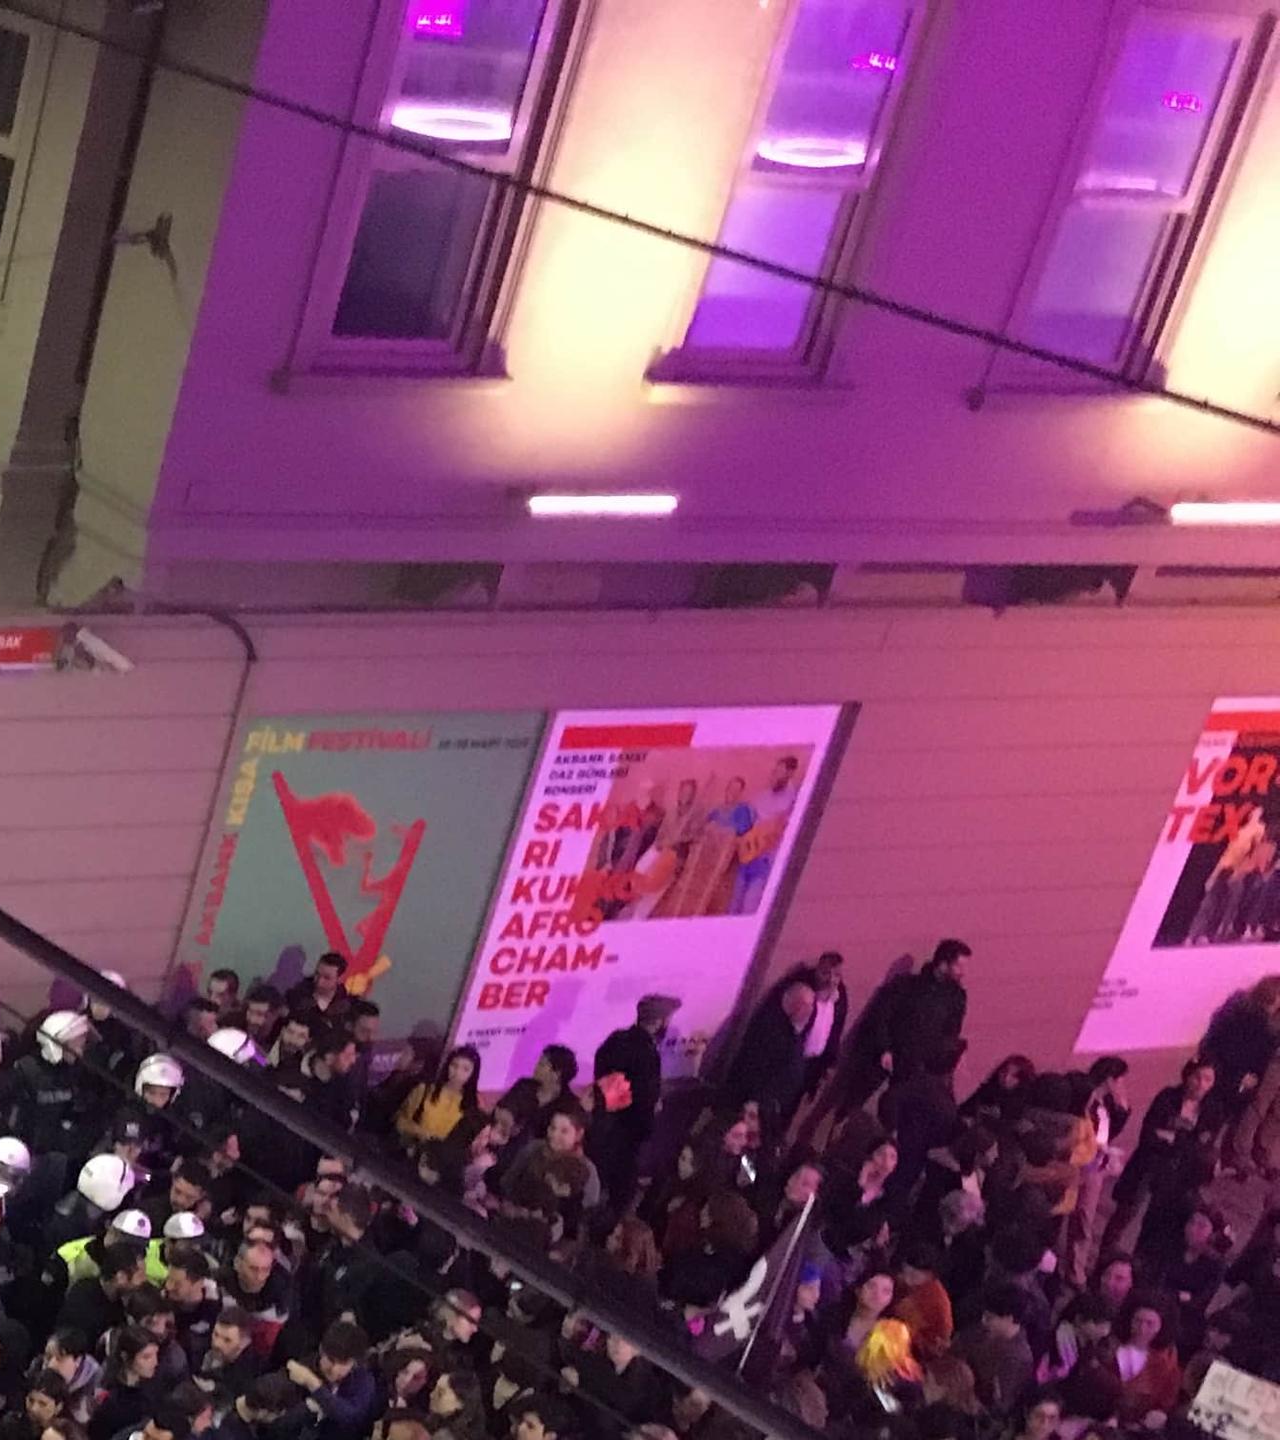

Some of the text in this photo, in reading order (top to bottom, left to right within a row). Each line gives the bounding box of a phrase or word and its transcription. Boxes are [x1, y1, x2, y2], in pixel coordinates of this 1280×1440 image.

[1168, 802, 1256, 844] TEX
[520, 838, 563, 870] RI
[498, 908, 603, 942] AFRO
[488, 943, 619, 977] CHAM-
[476, 978, 552, 1012] BER
